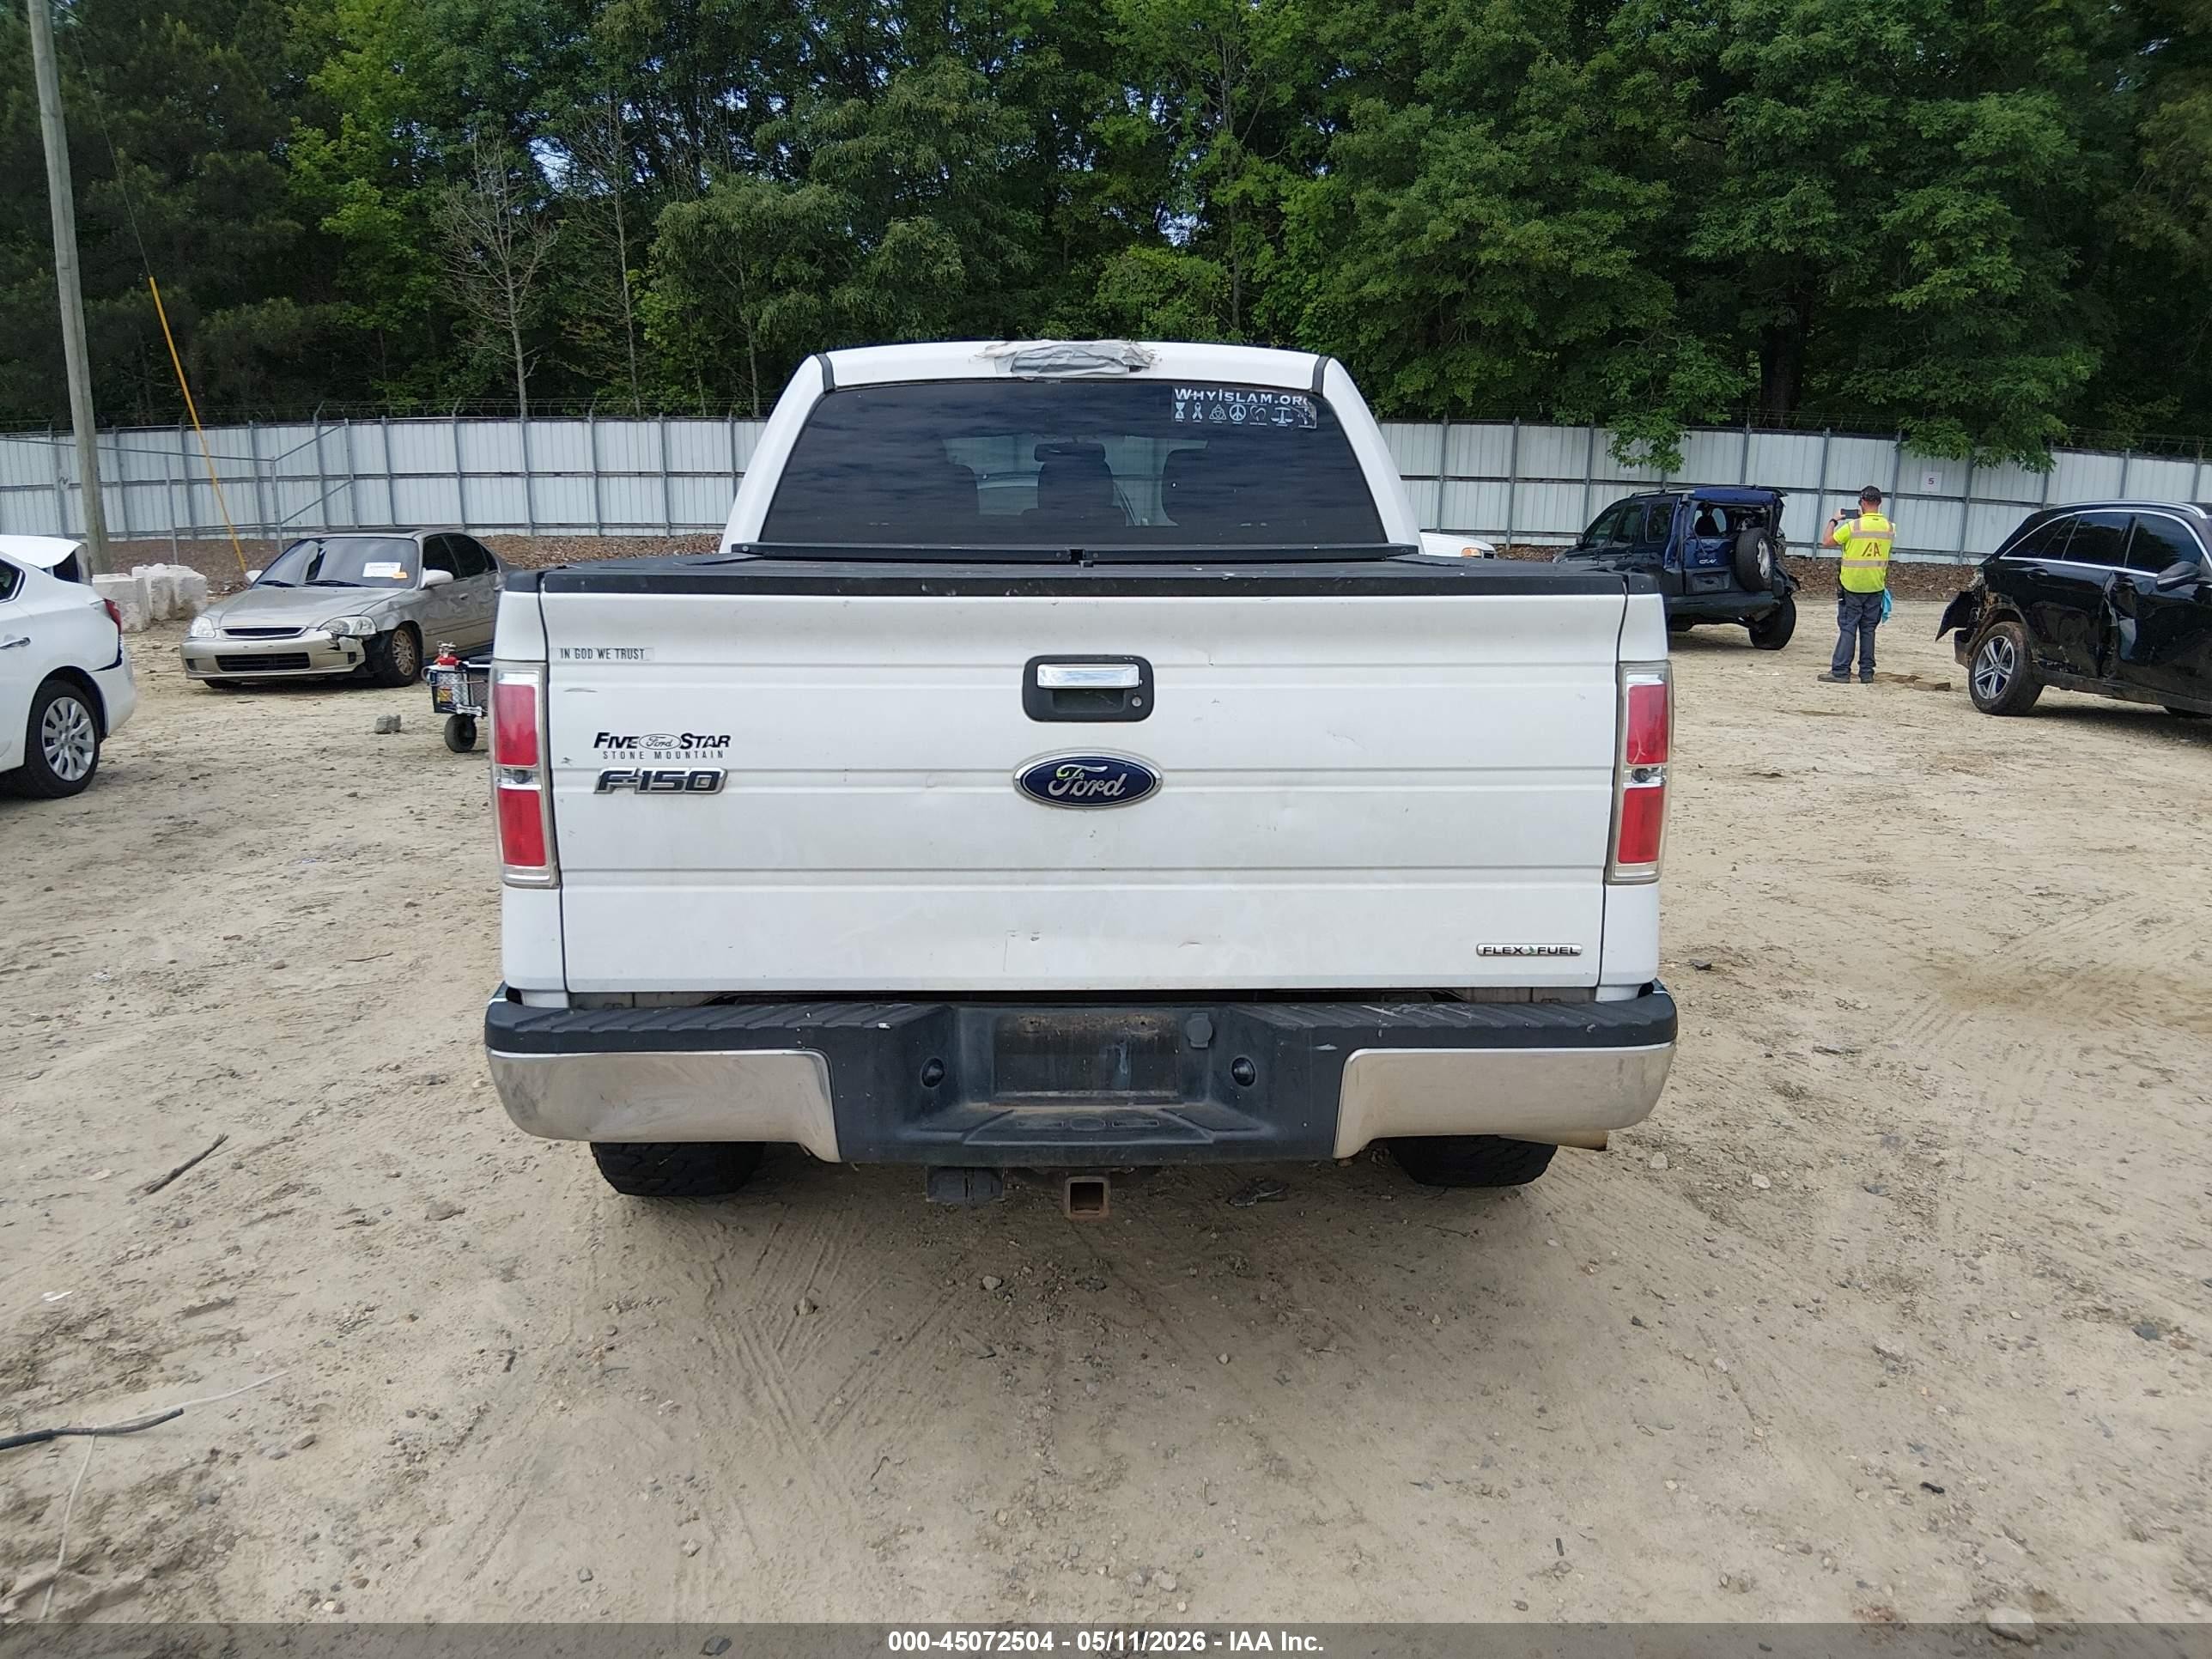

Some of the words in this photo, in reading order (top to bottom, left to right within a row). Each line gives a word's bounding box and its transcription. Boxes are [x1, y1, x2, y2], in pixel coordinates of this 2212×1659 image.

[561, 647, 570, 659] IN
[574, 647, 593, 659] GOD
[597, 647, 611, 659] WE
[614, 647, 645, 659] TRUST
[593, 732, 640, 749] FIVE
[679, 732, 731, 750] STAR
[603, 750, 645, 760] STONE
[653, 750, 724, 760] MOUNTAIN
[594, 767, 727, 794] F-150
[1048, 763, 1127, 797] Ford
[1482, 946, 1523, 955] FLEX
[1537, 946, 1578, 955] FUEL
